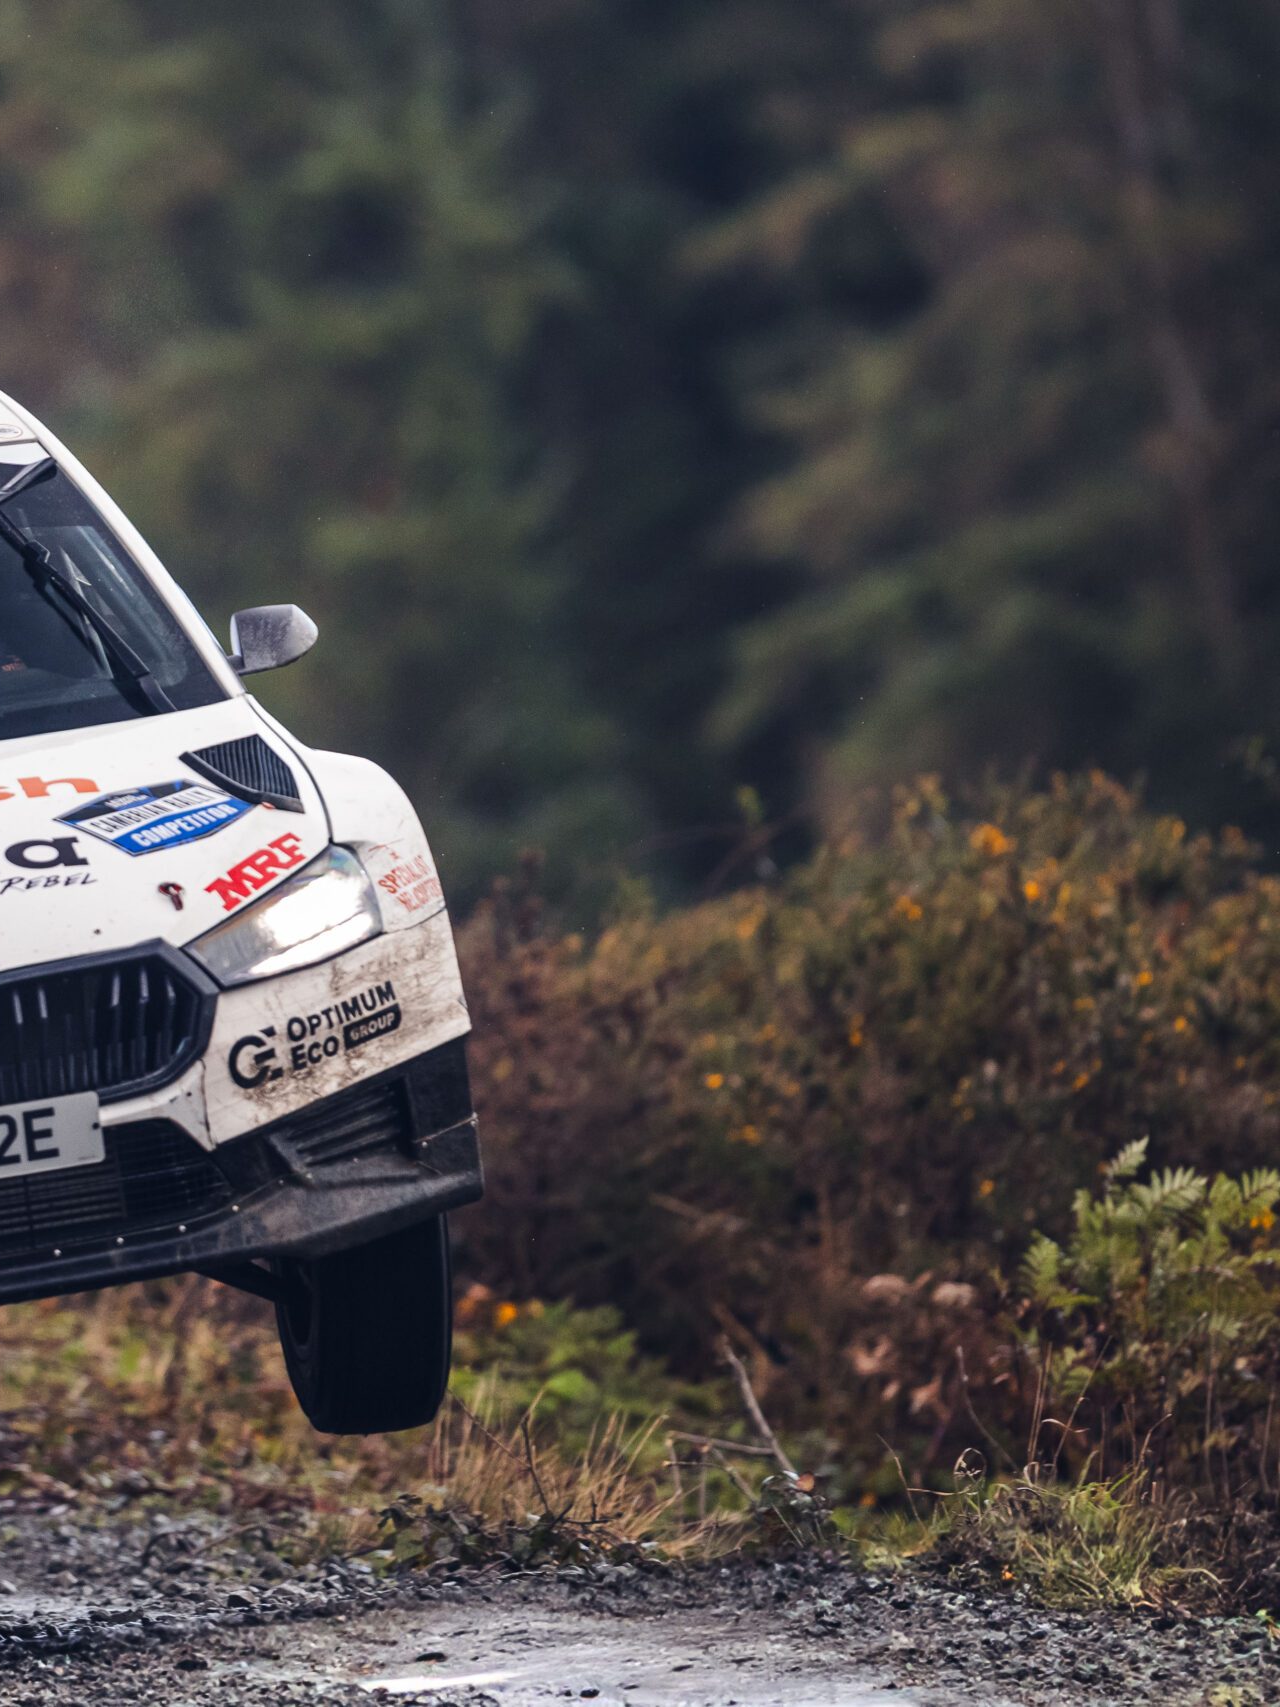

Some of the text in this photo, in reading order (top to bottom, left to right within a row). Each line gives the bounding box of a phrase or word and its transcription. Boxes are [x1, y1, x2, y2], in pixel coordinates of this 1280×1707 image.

[90, 803, 171, 834] CAMBRIAN
[164, 789, 216, 809] RALLY
[130, 803, 239, 848] COMPETITOR
[204, 832, 308, 912] MRF
[286, 980, 397, 1042] OPTIMUM
[349, 1011, 396, 1041] GROUP
